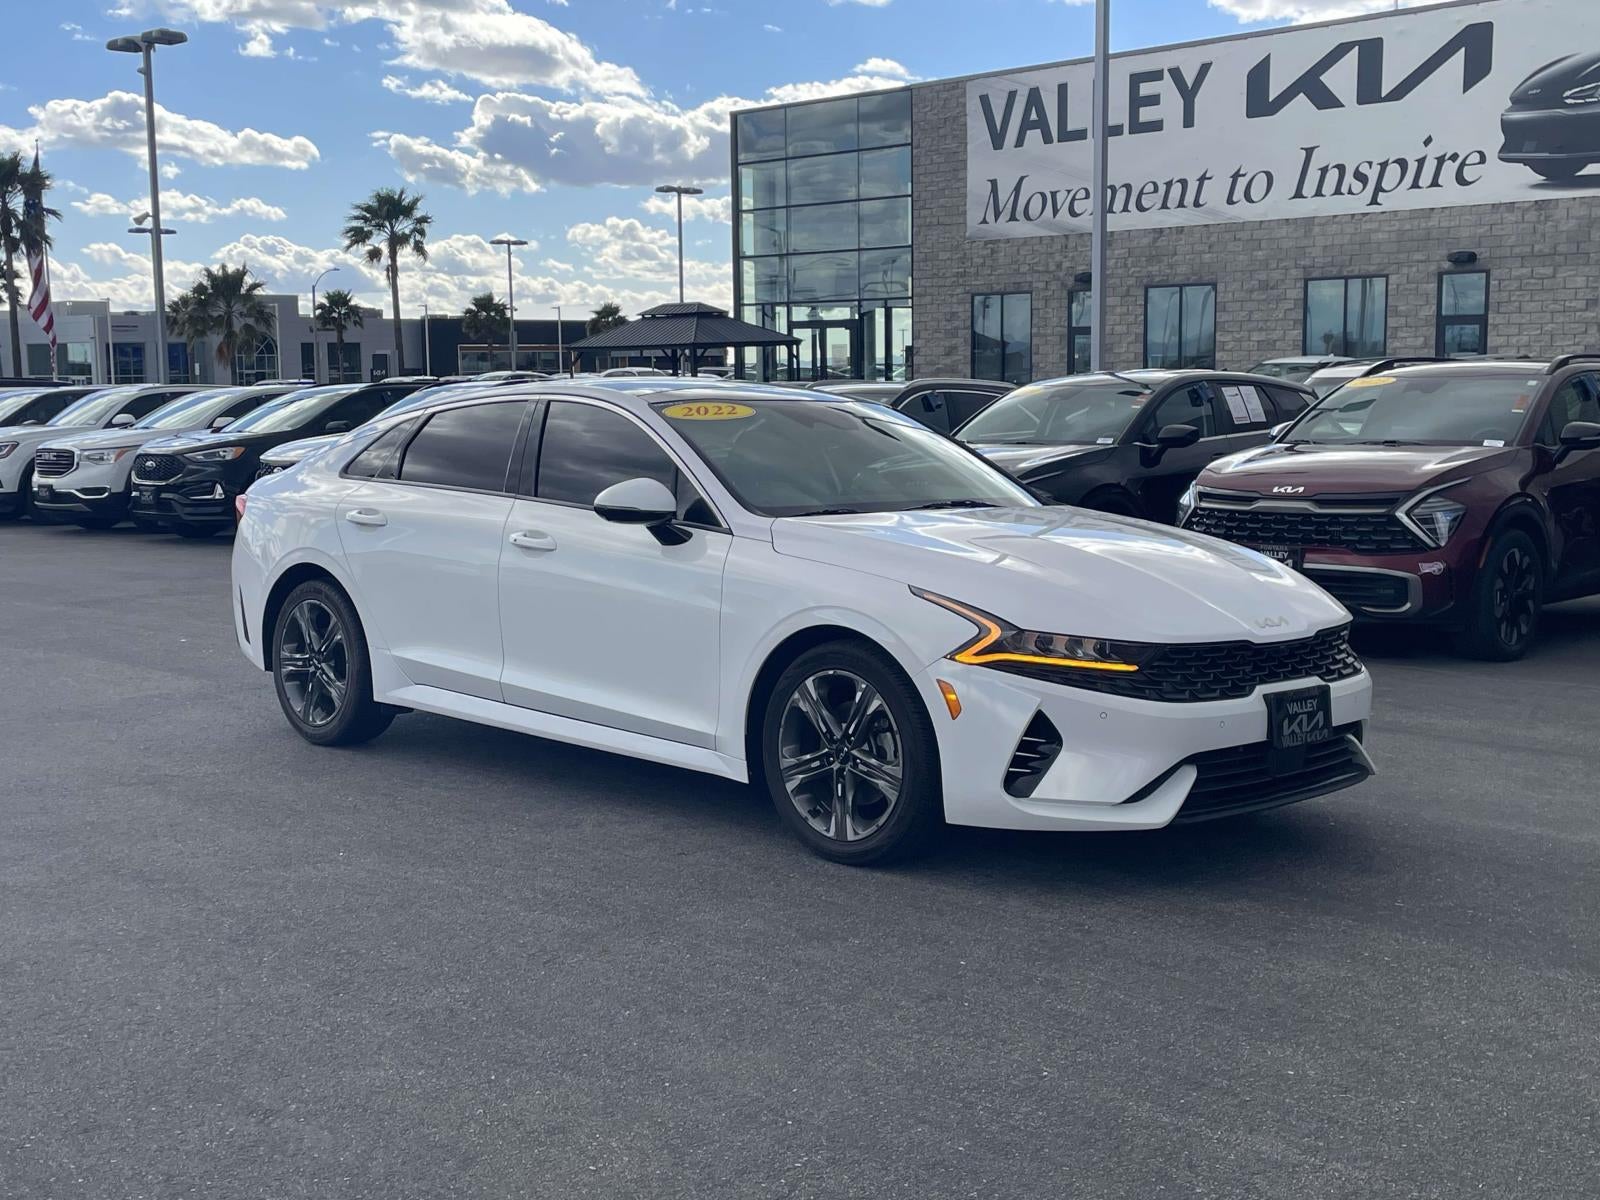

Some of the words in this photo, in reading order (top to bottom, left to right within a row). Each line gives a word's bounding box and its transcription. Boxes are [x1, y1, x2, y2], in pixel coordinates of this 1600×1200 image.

[1246, 20, 1494, 119] KIA
[977, 168, 1214, 225] Movement
[1226, 164, 1274, 206] to
[1289, 134, 1487, 206] Inspire
[681, 405, 738, 417] 2022
[1286, 698, 1318, 715] VALLEY
[1283, 710, 1324, 736] KIA
